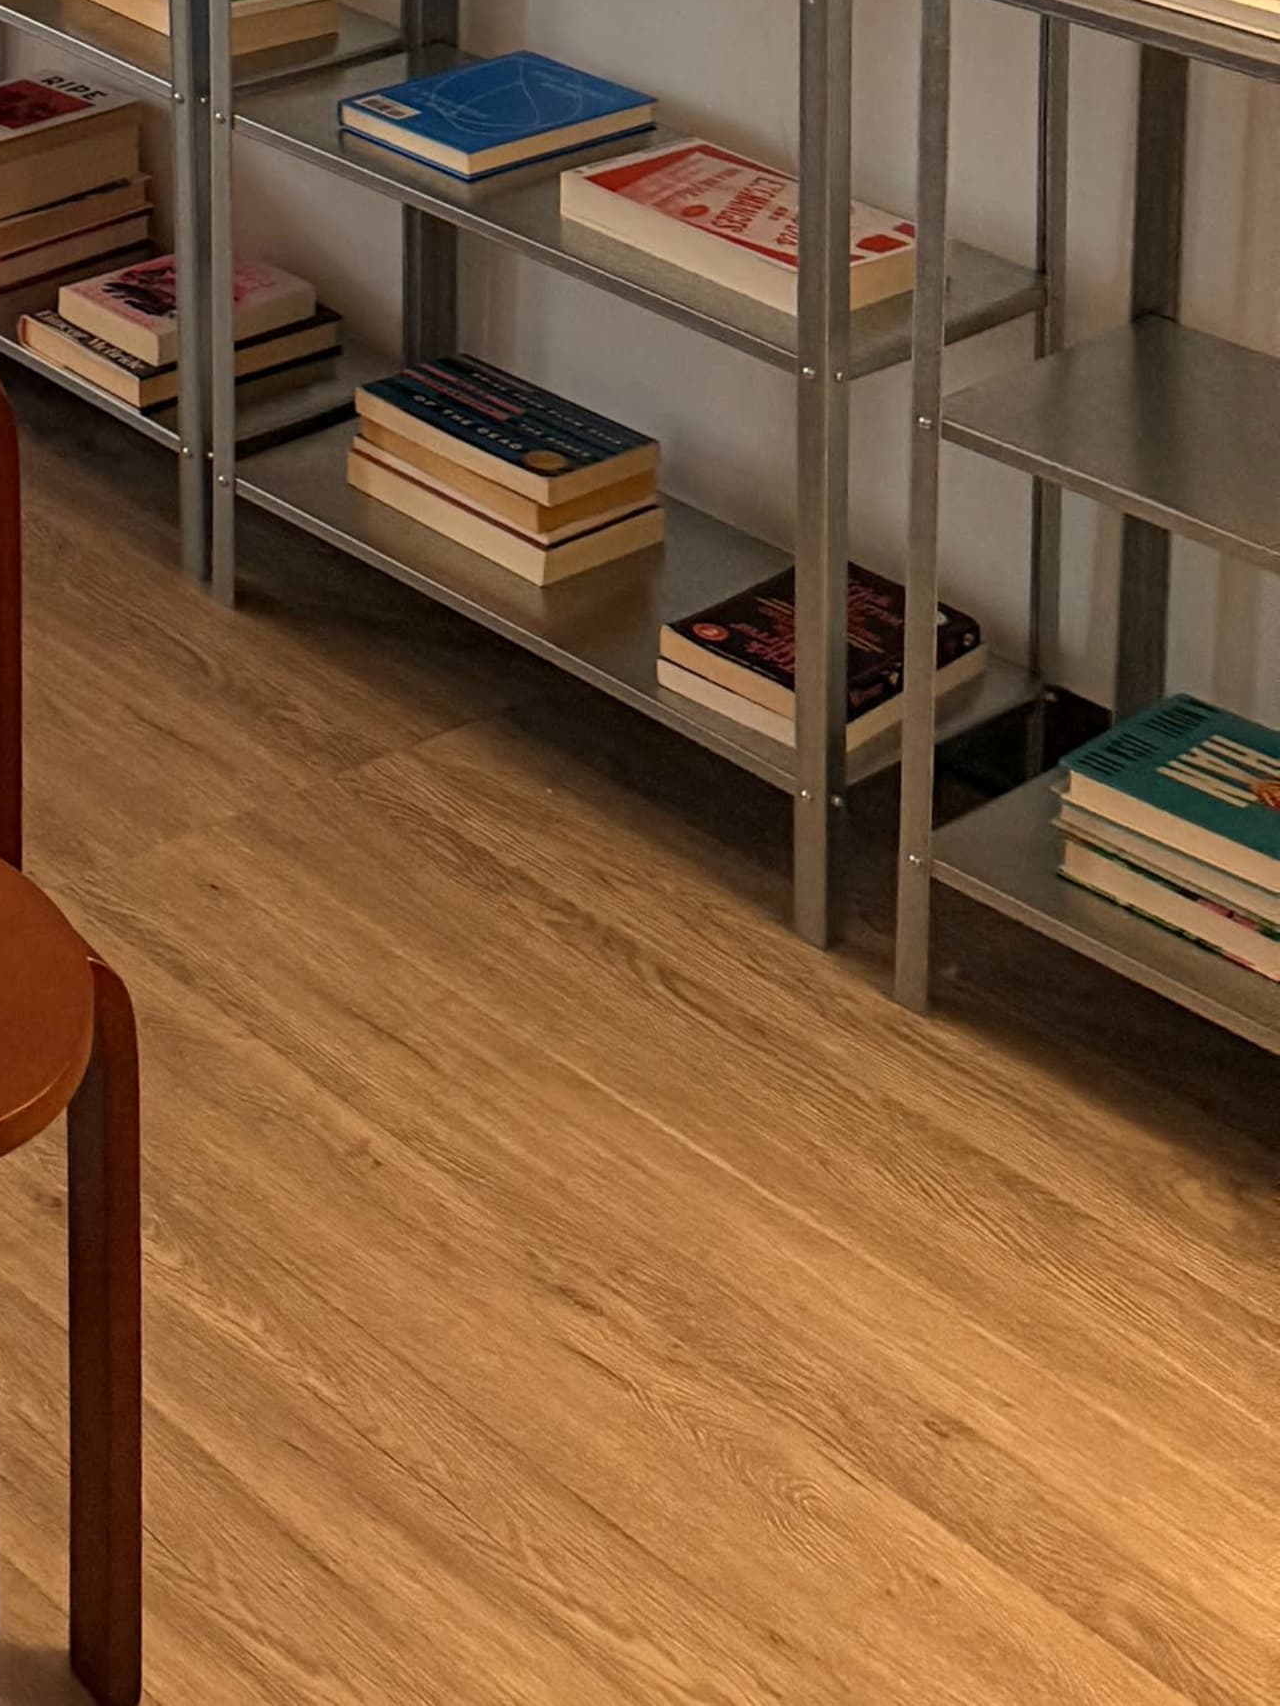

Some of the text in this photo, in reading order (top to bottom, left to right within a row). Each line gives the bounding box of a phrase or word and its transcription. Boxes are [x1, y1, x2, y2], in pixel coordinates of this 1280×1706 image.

[40, 75, 107, 101] RIPE
[710, 175, 787, 233] EXCHANGES
[413, 396, 525, 451] OF THE DEAD
